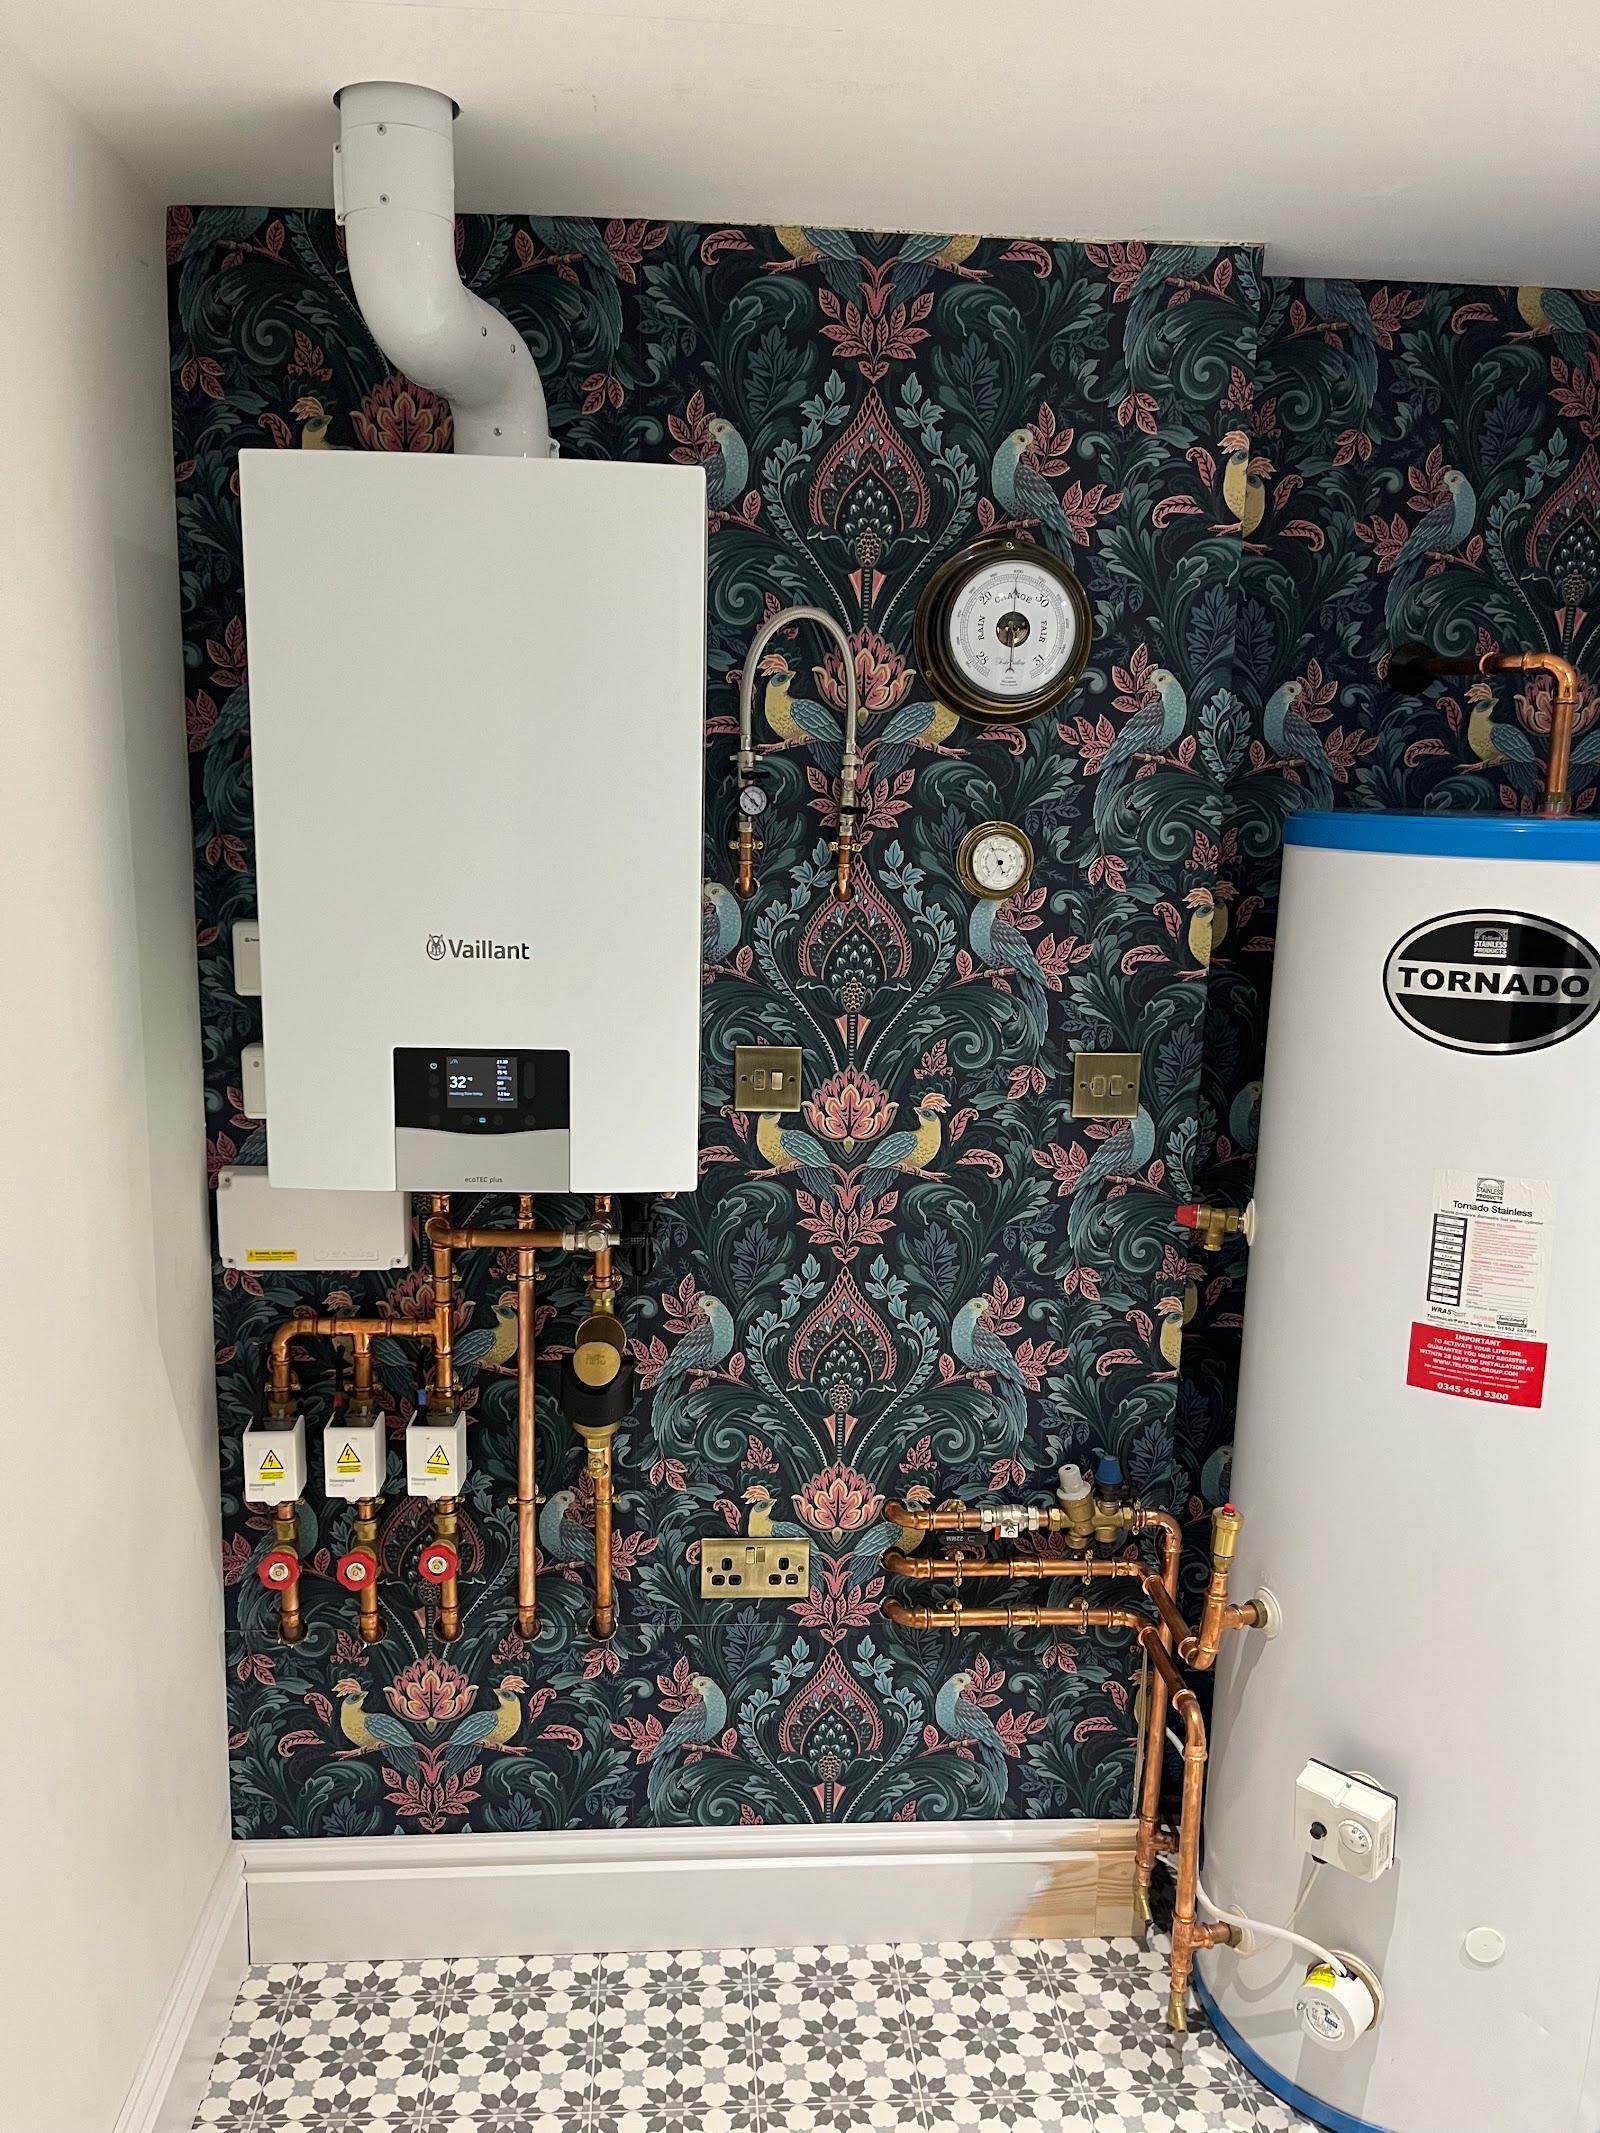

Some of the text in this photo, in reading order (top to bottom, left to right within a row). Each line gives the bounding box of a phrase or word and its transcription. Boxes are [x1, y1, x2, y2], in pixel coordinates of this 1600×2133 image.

[980, 590, 992, 606] 29
[1035, 593, 1050, 608] 30
[978, 615, 986, 641] RAIN
[1038, 620, 1048, 643] FAIR
[976, 651, 990, 665] 28
[1033, 654, 1045, 666] 31
[448, 939, 530, 960] Vaillant
[1398, 966, 1590, 998] TORNADO
[1453, 1200, 1533, 1217] Tornado Stainless
[1431, 1306, 1452, 1315] WRAS
[1443, 1340, 1472, 1350] ACTIVATE
[1474, 1344, 1491, 1353] YOUR
[1492, 1348, 1521, 1356] LIFETIME
[1455, 1334, 1501, 1346] IMPORTANT
[1419, 1348, 1443, 1358] WITHIN
[1452, 1355, 1469, 1363] DAYS
[1480, 1359, 1526, 1371] INSTALLATION
[1427, 1343, 1462, 1354] GUARANTEE
[1496, 1355, 1527, 1364] REGISTER
[1433, 1358, 1519, 1376] WWW.TELFORD-GROUP.COM
[1437, 1382, 1509, 1401] 0345 450 5300
